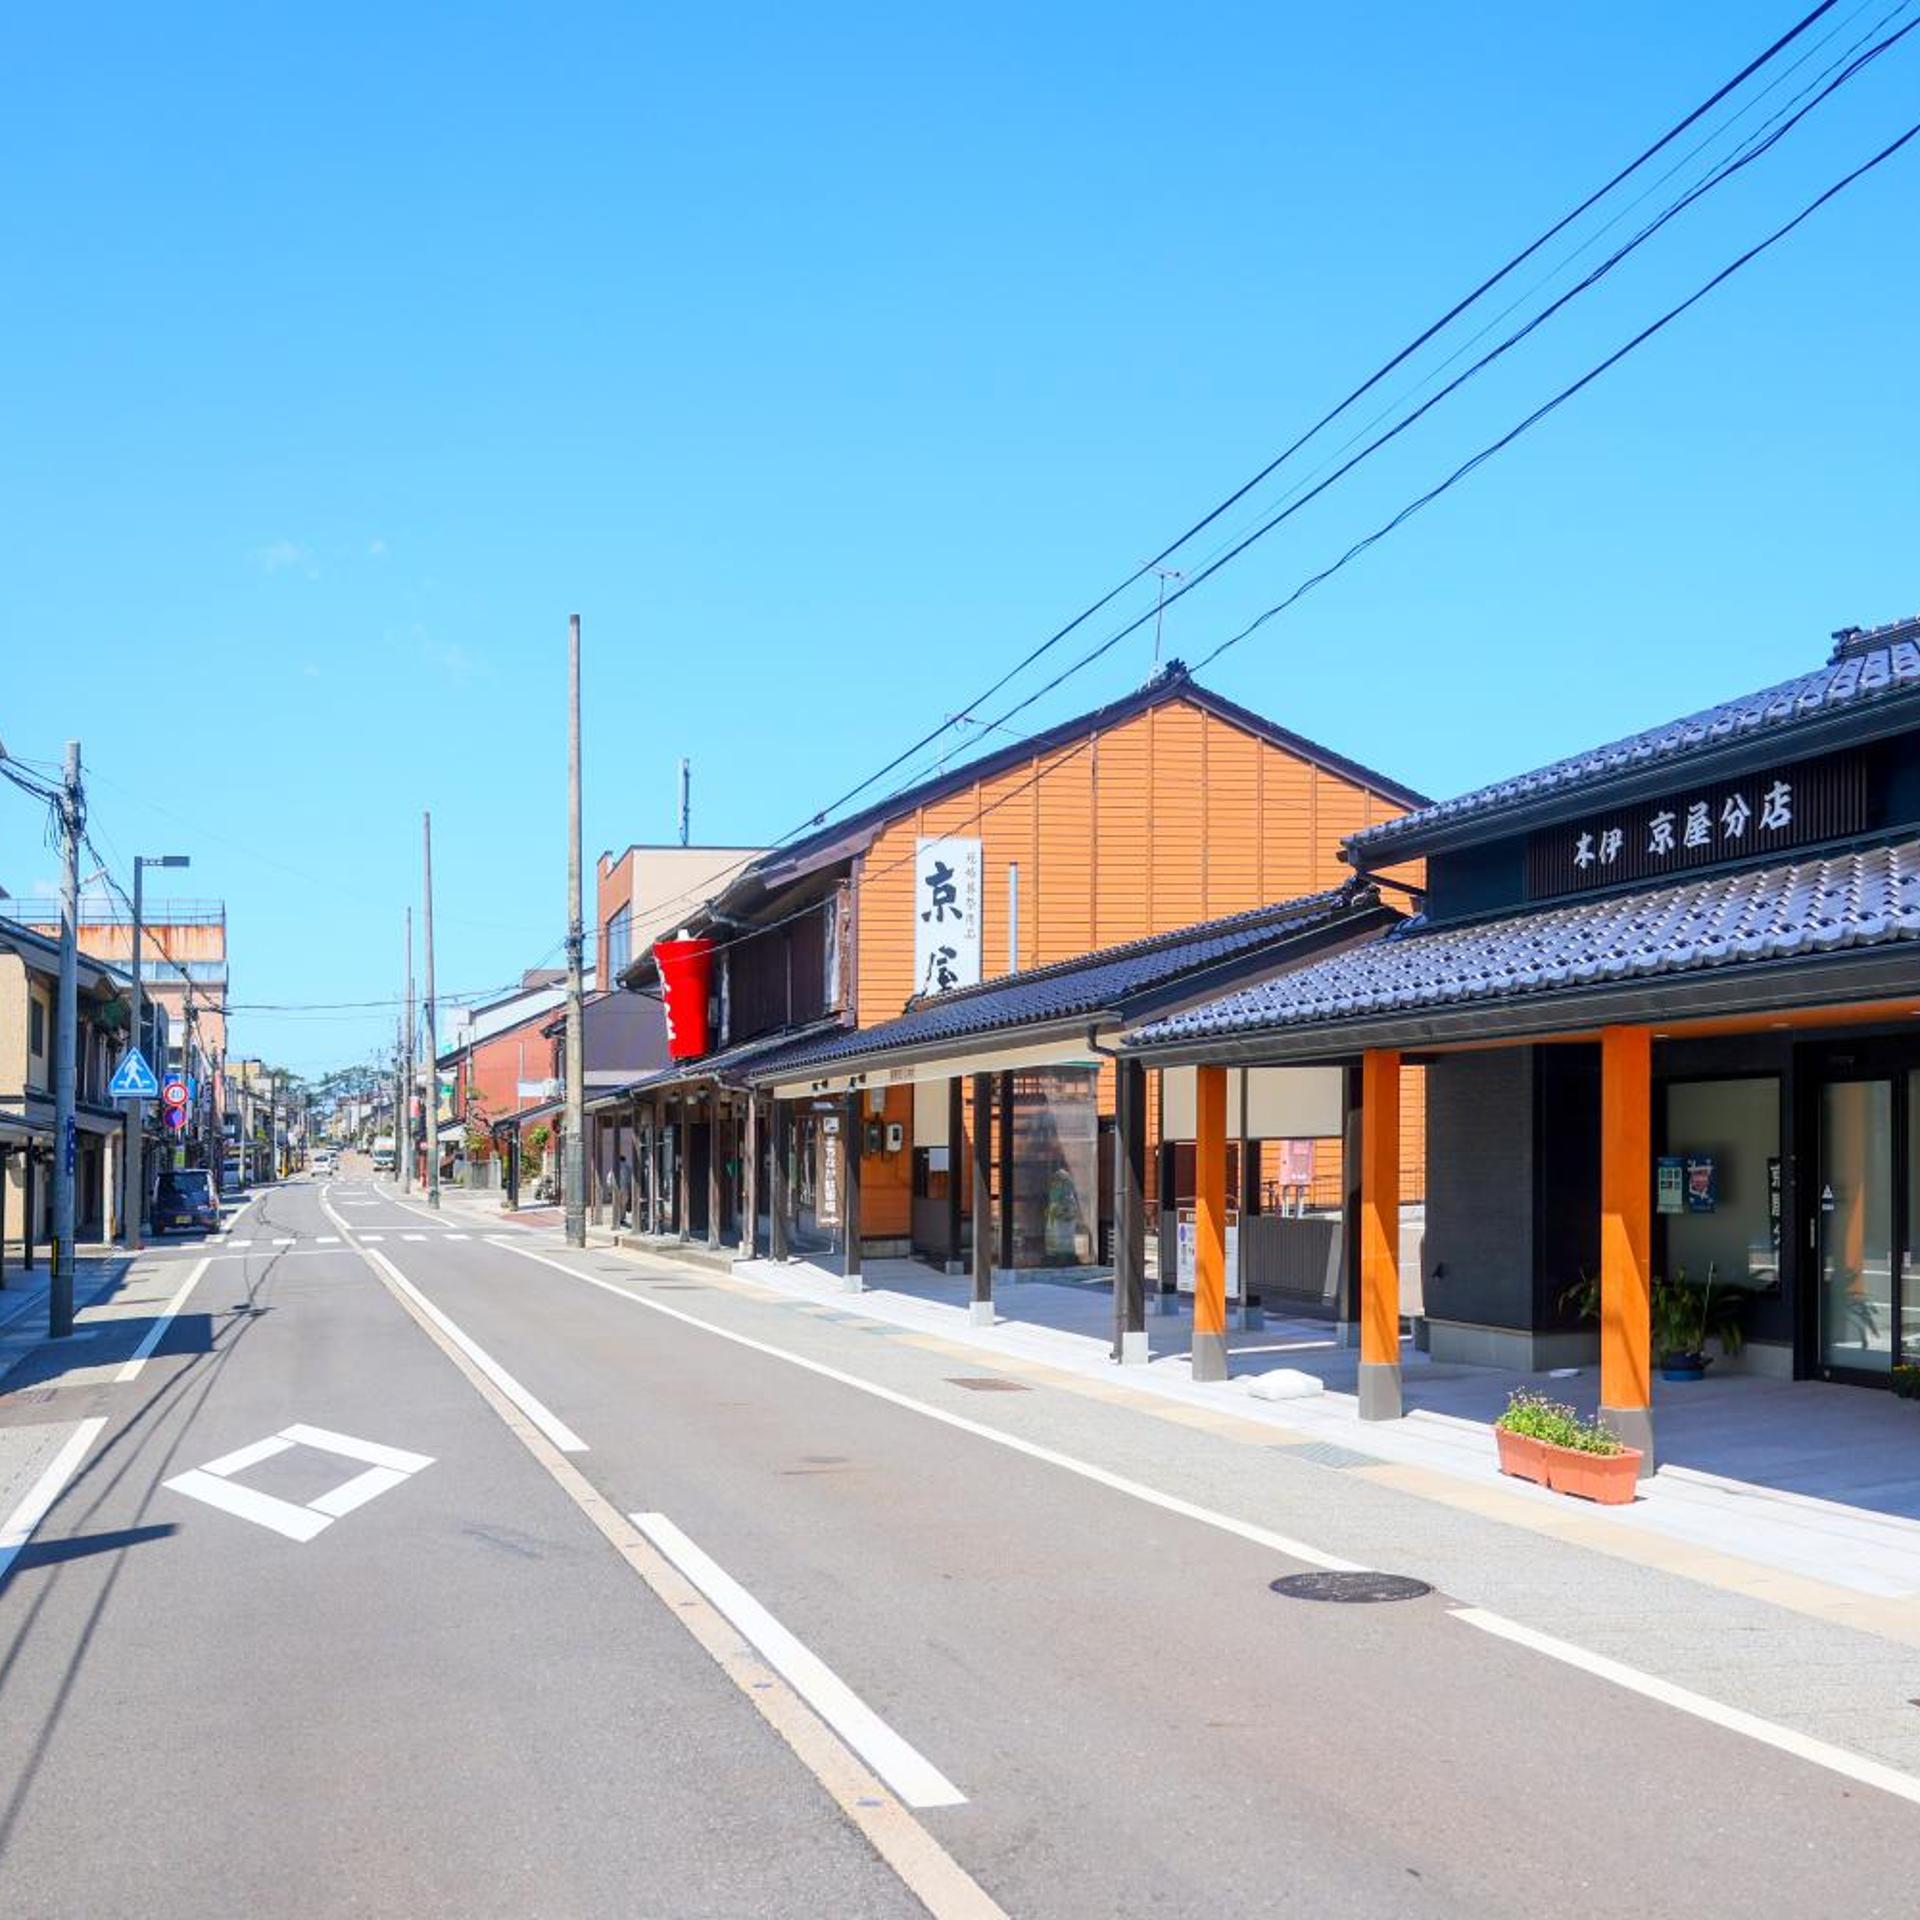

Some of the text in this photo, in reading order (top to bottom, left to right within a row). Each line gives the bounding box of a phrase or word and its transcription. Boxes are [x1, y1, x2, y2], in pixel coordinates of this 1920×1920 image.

[1648, 780, 1793, 855] 京屋分店
[920, 860, 963, 994] 京屋
